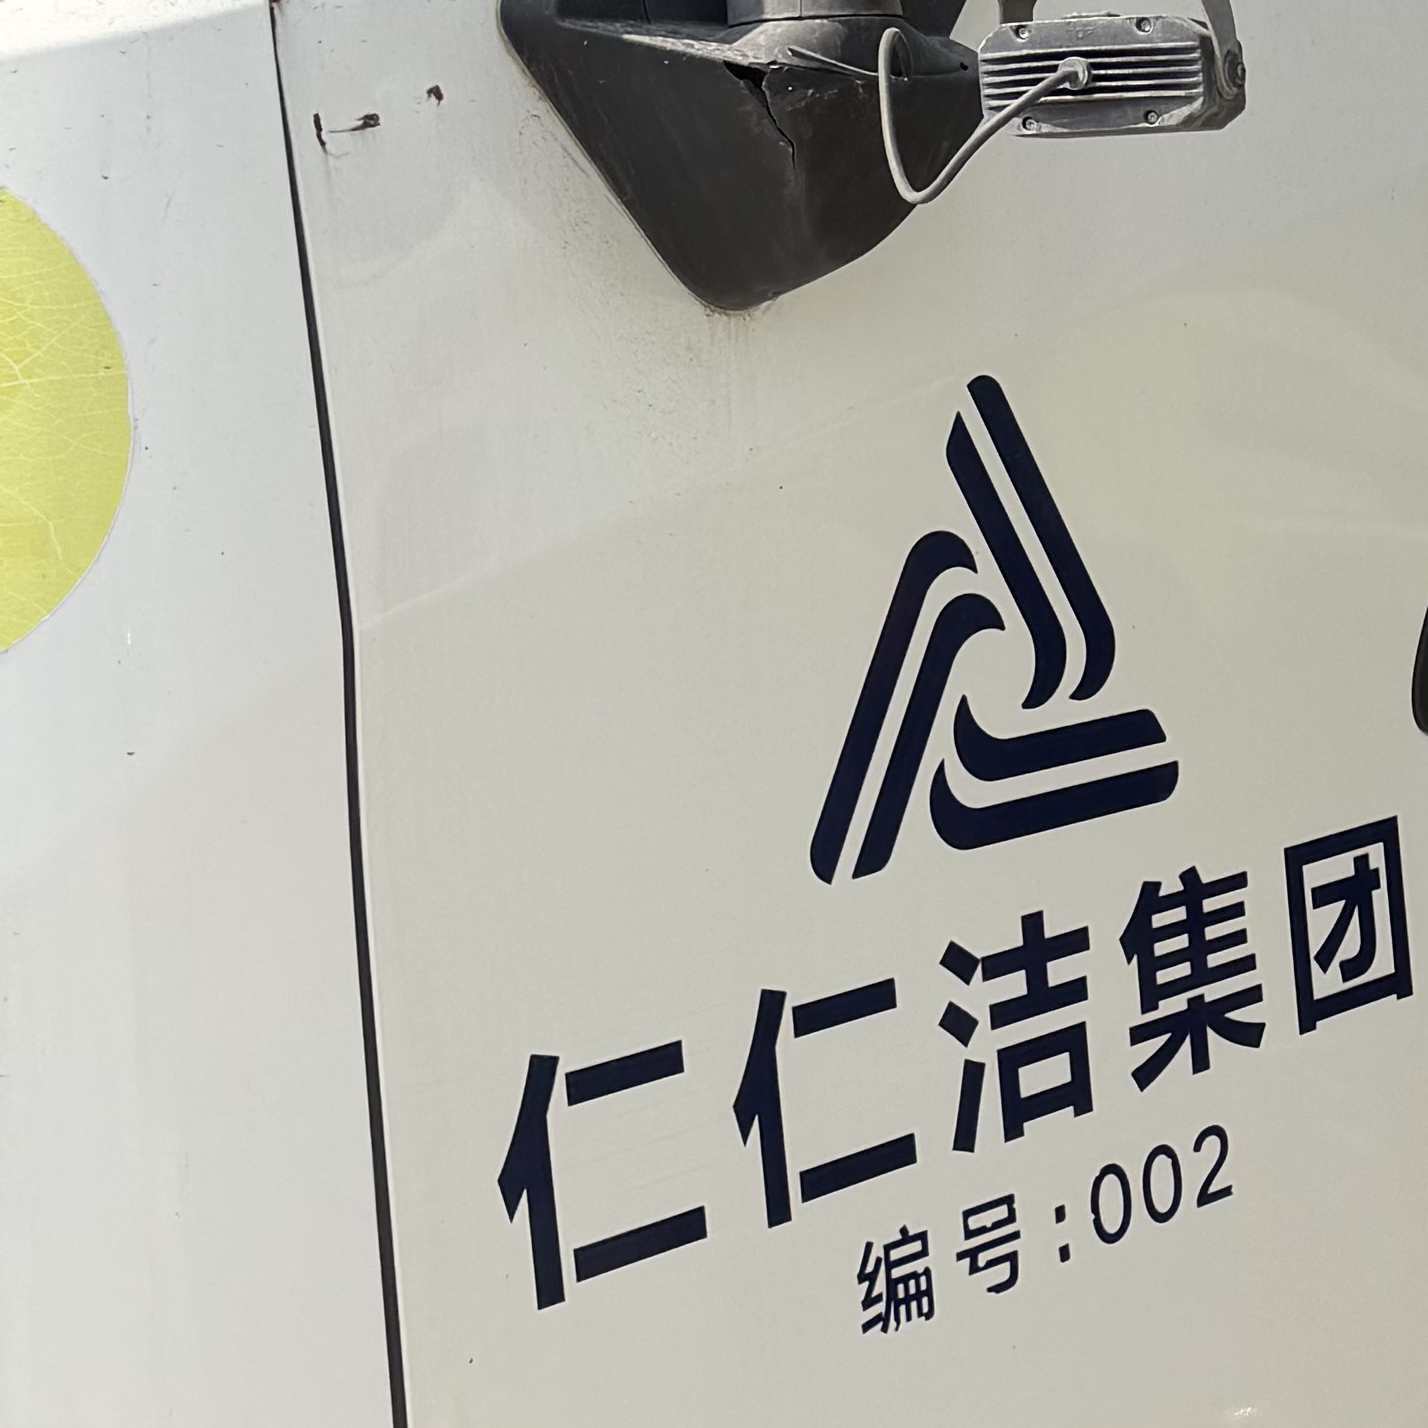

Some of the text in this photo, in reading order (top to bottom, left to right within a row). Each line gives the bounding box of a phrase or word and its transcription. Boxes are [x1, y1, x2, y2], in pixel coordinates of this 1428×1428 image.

[497, 815, 1414, 1310] 仁仁洁集团
[856, 1124, 1234, 1335] 编号:002
